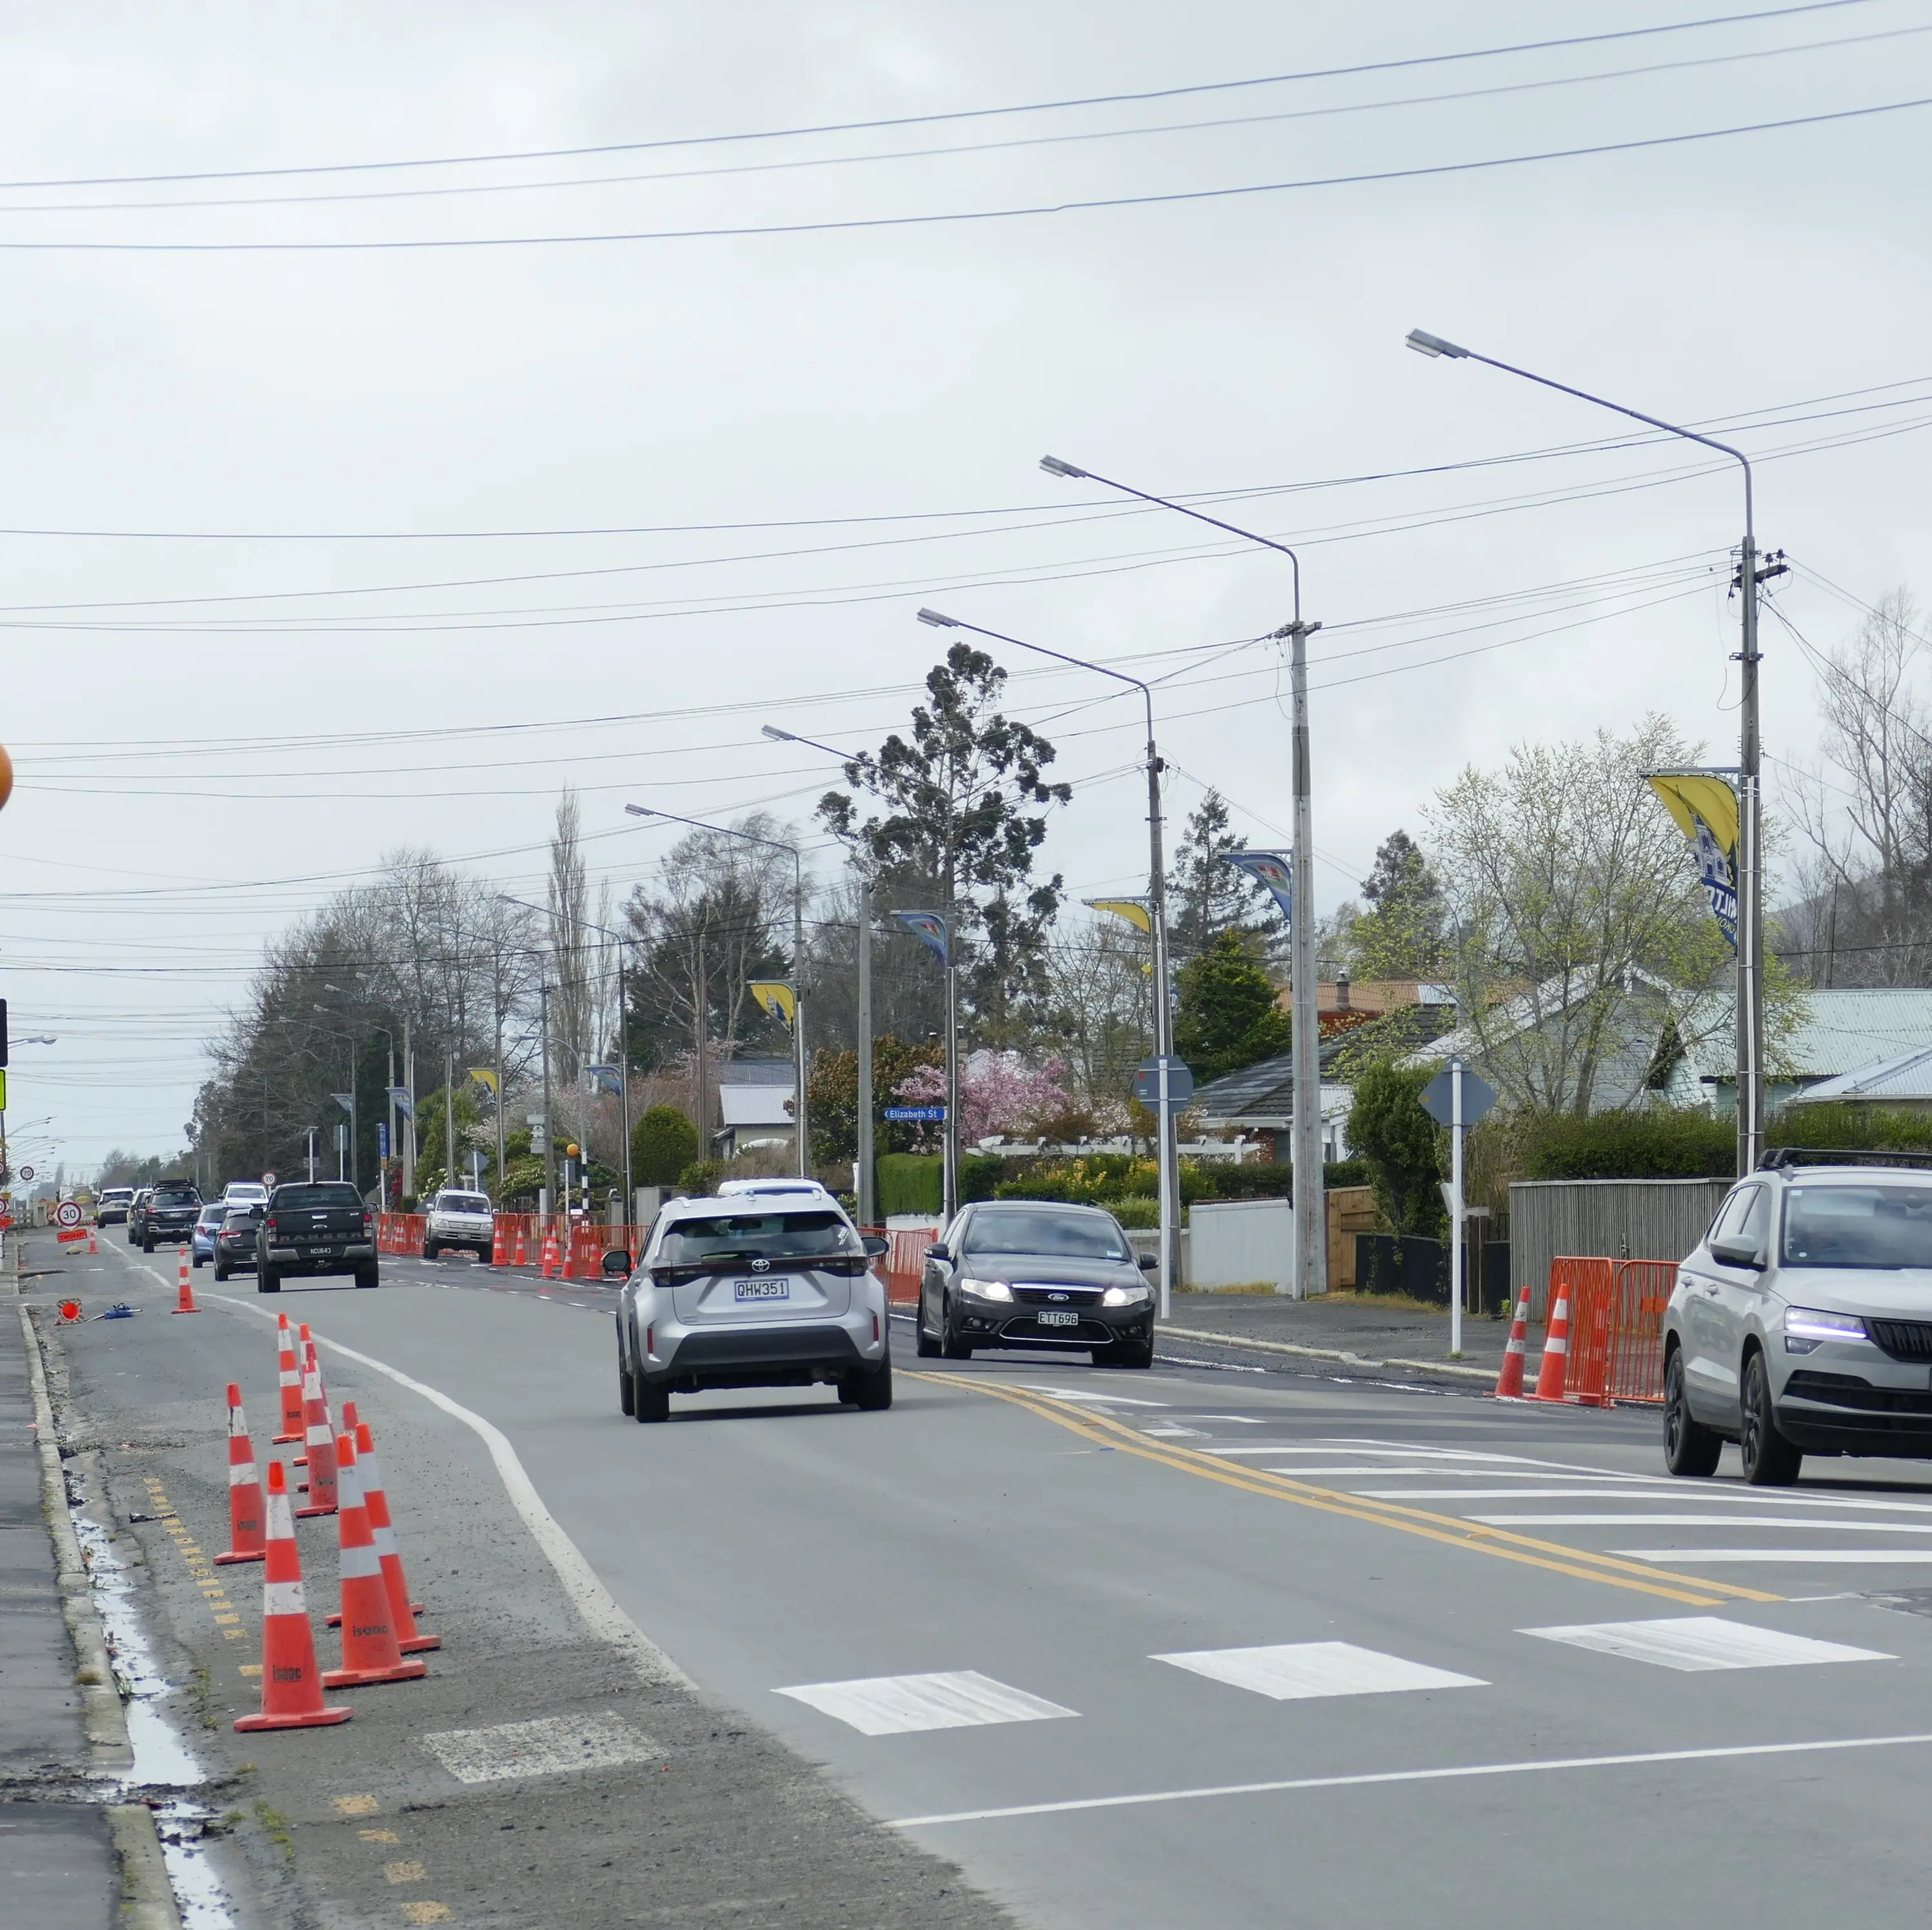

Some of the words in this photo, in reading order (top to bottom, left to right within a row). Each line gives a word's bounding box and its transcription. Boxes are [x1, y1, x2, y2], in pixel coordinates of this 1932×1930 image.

[928, 1109, 937, 1118] St
[63, 1209, 75, 1219] 30
[738, 1282, 784, 1296] QHW351
[1040, 1313, 1077, 1324] ETT696
